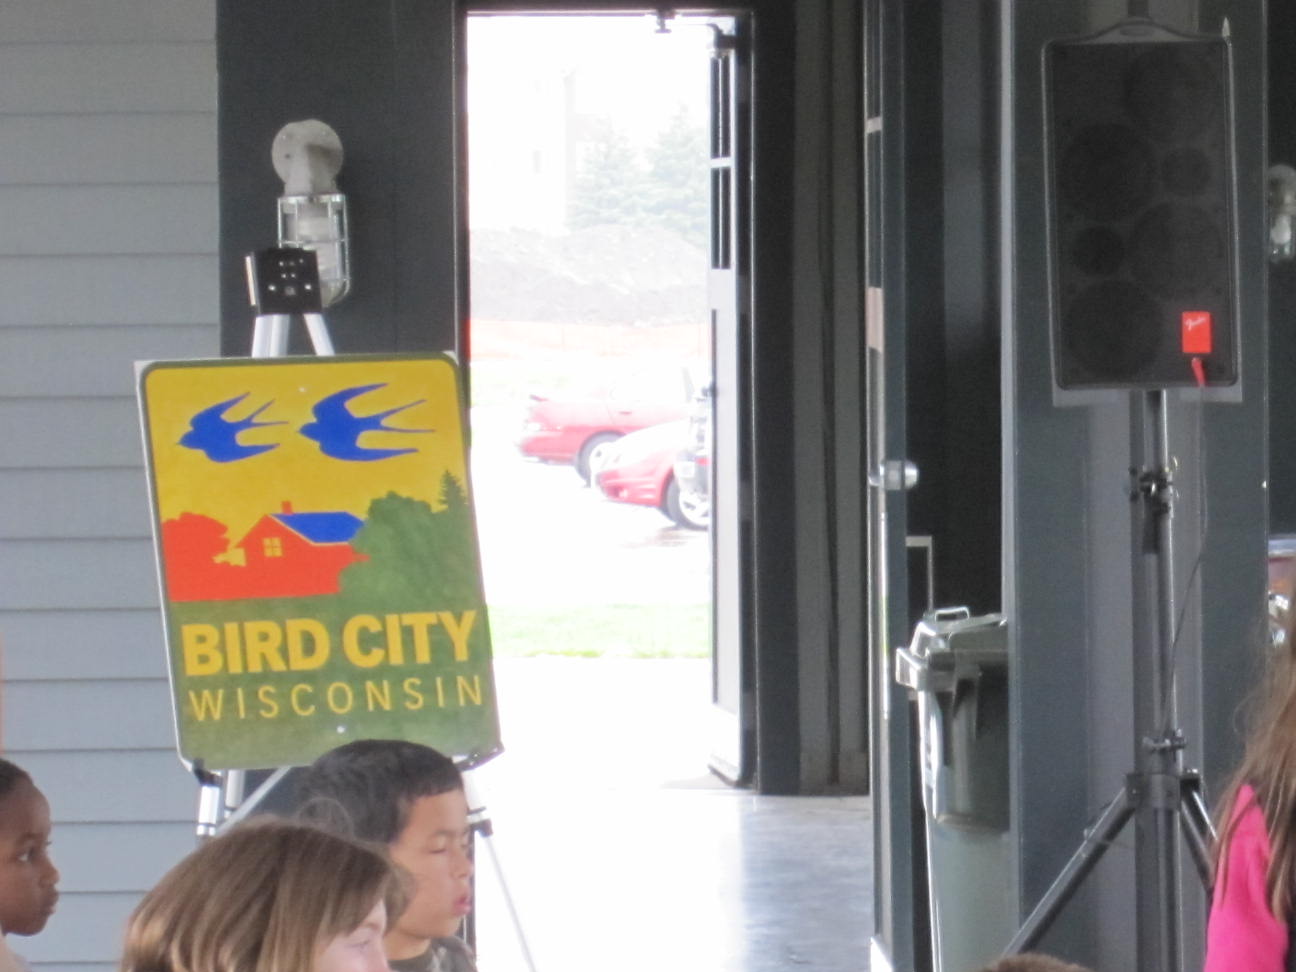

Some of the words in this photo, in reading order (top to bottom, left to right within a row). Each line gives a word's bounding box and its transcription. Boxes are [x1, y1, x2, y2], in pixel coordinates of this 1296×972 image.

[182, 618, 330, 676] BIRD
[343, 610, 477, 668] CITY
[189, 675, 482, 721] WISCONSIN
